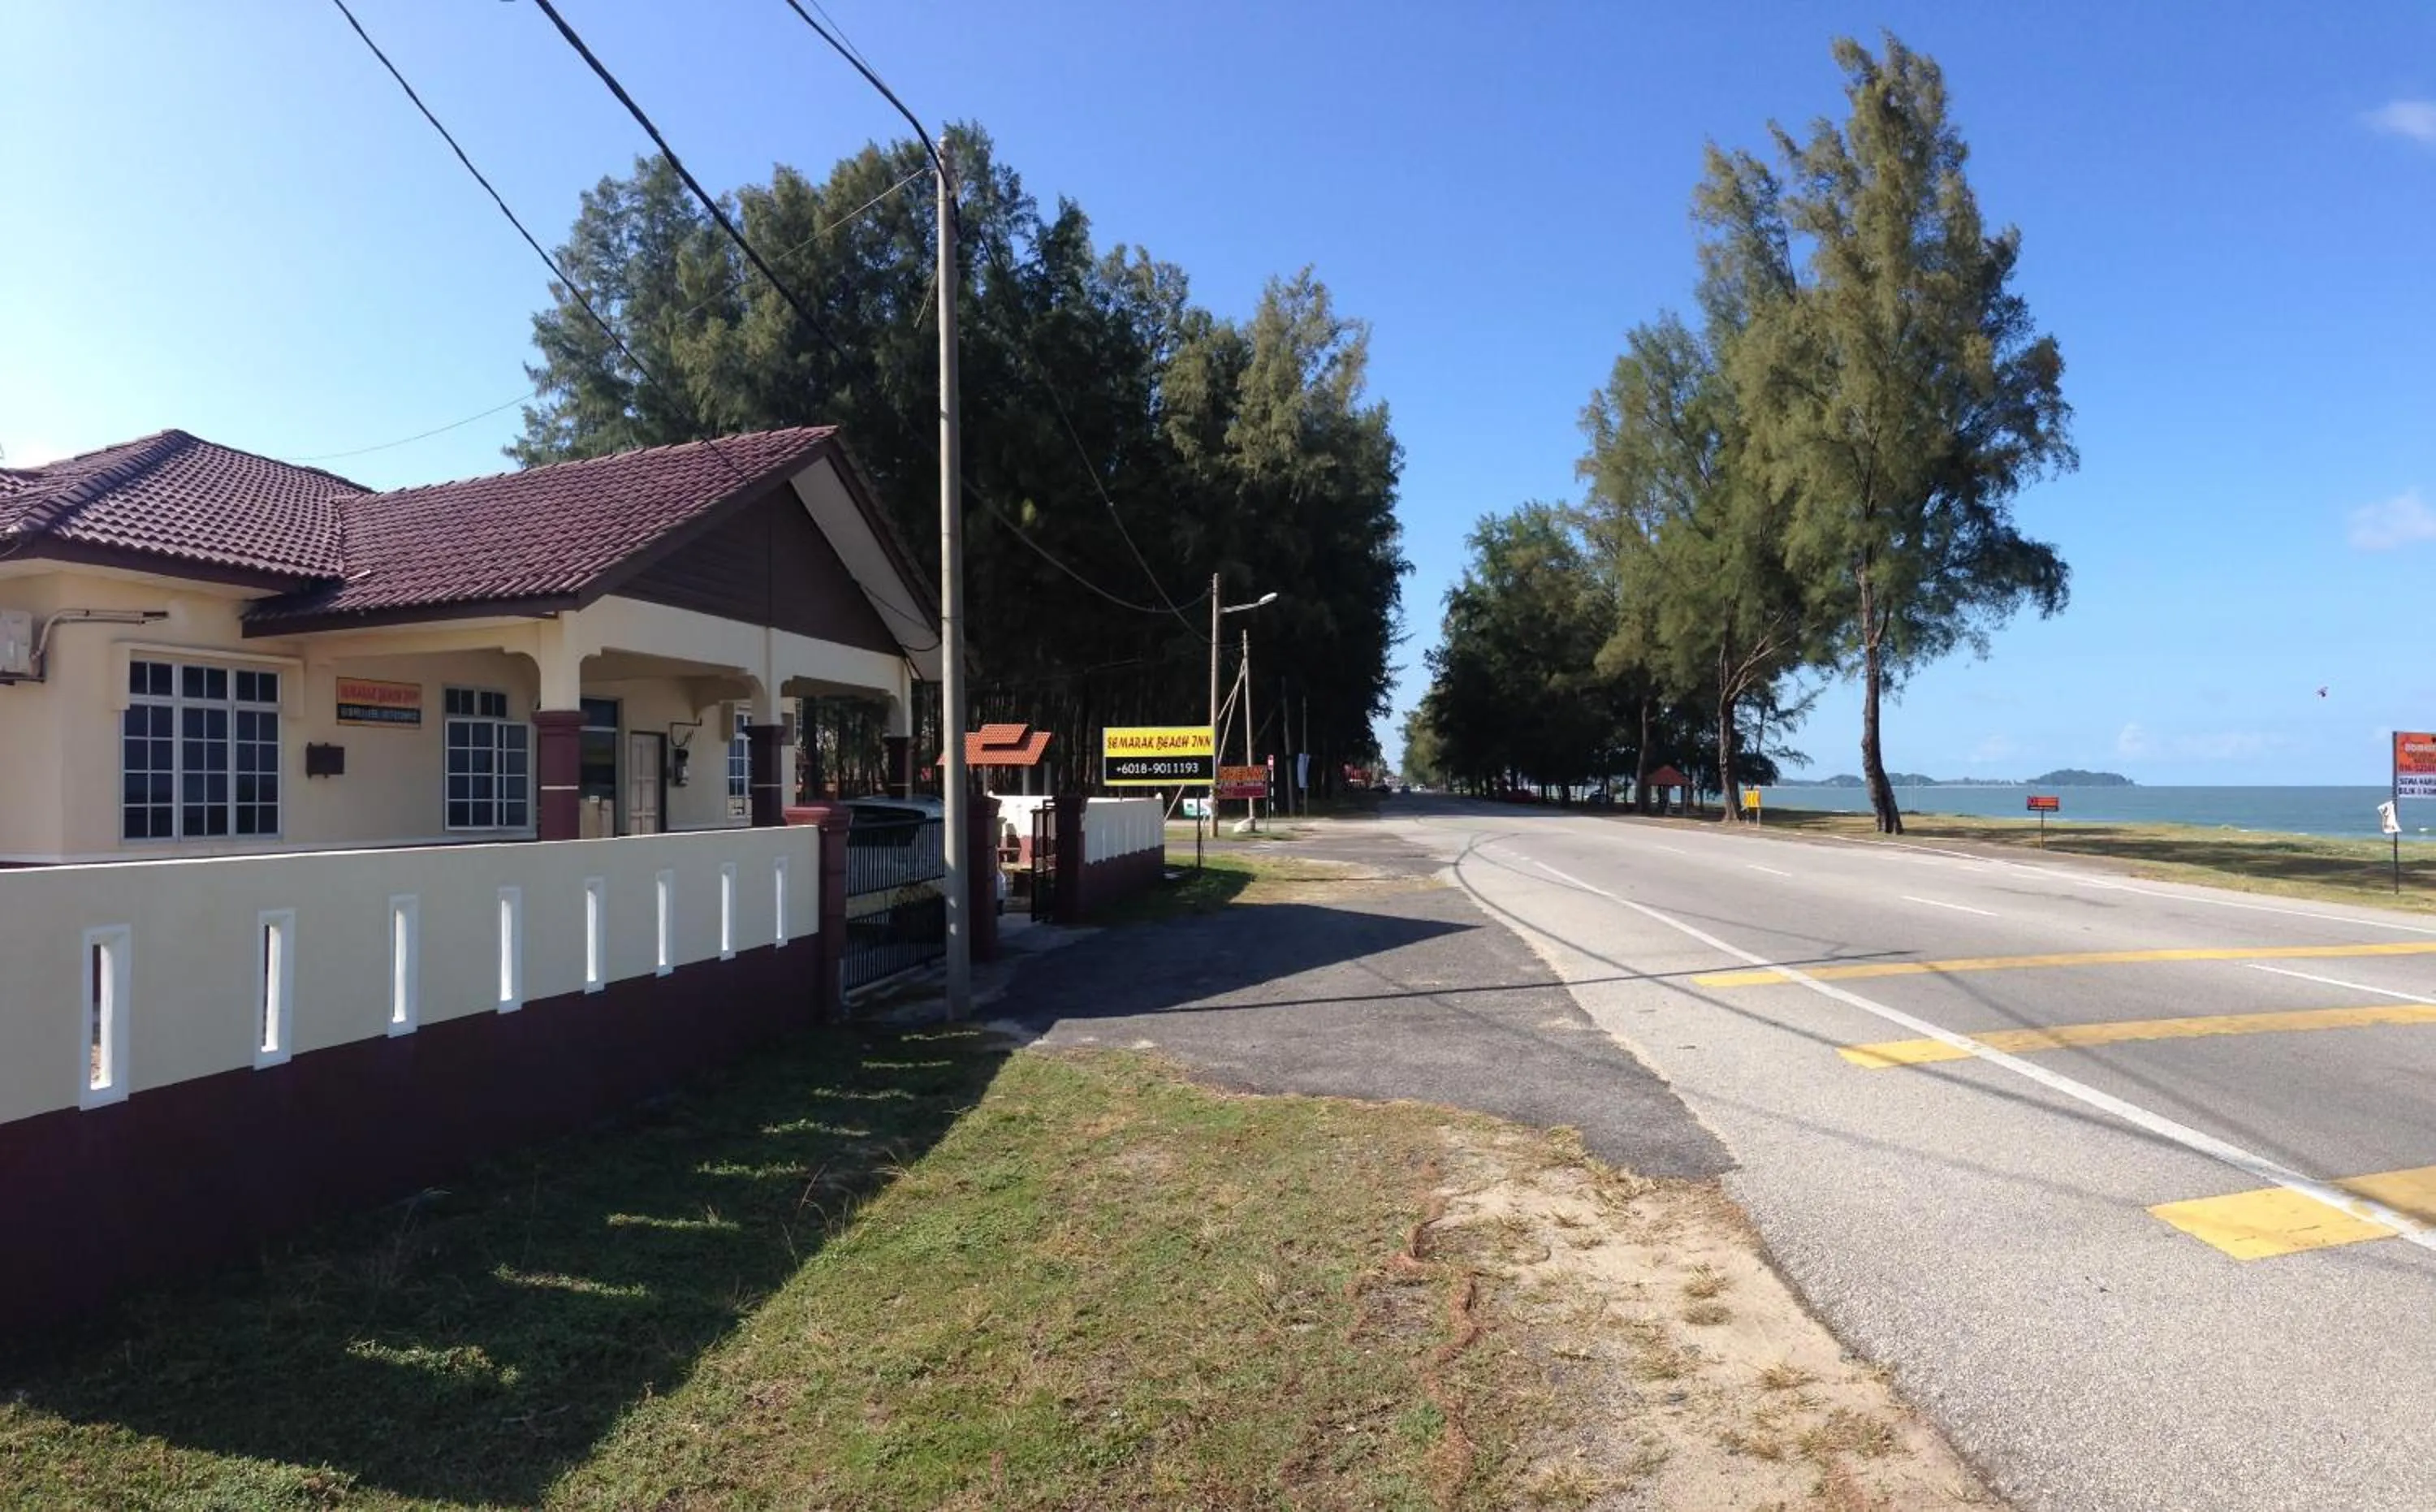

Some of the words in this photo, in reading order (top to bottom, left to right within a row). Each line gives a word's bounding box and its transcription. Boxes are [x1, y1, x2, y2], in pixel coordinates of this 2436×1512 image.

[1107, 736, 1154, 750] SEMARAK
[1155, 735, 1190, 750] BEACH
[1116, 762, 1199, 774] +6018-9011193
